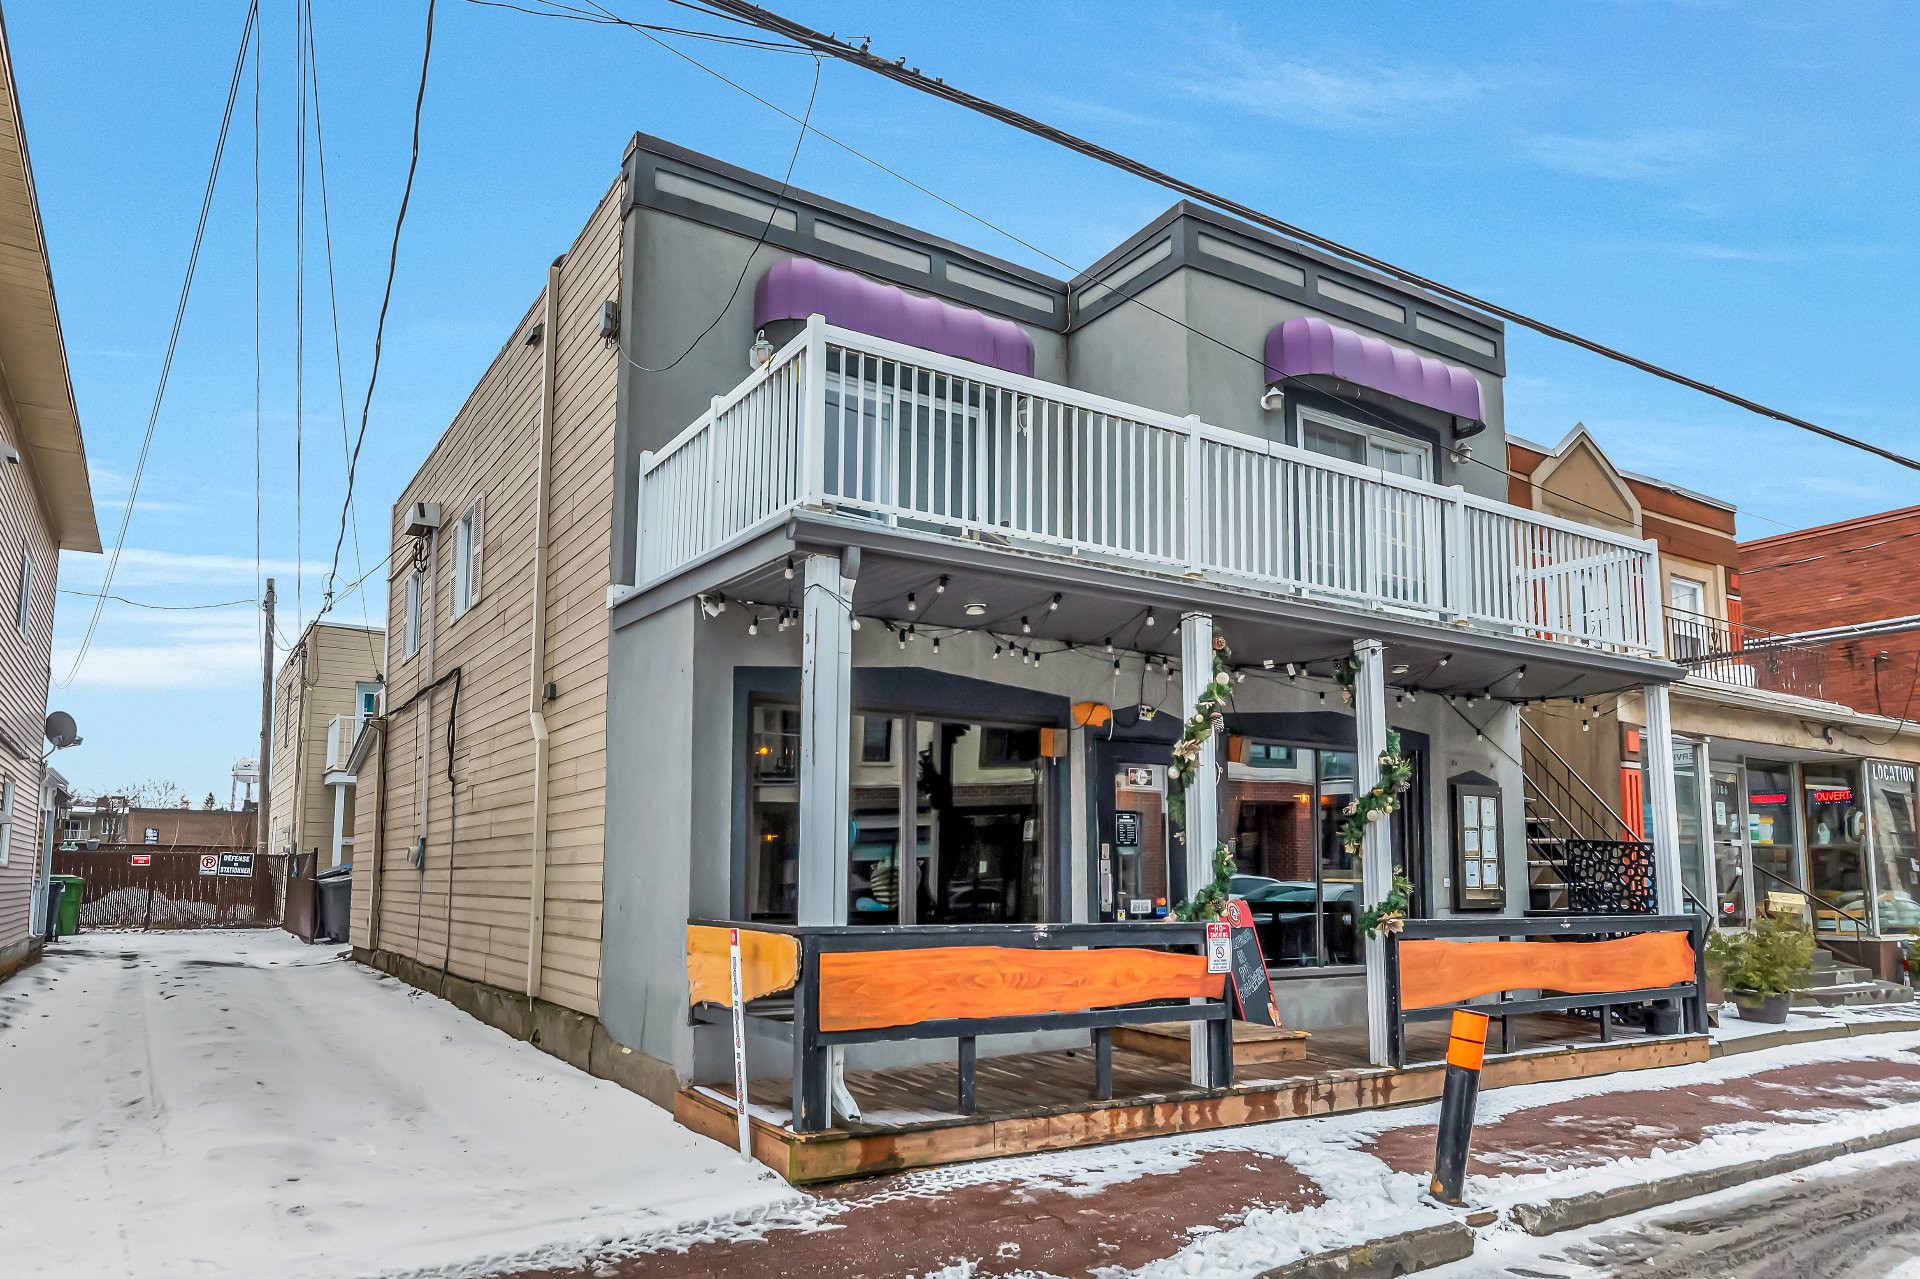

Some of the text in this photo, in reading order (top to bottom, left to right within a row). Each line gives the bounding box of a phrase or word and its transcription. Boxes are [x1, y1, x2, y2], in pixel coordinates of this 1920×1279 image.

[1872, 763, 1915, 783] LOCATION
[1816, 790, 1851, 801] OUVERT
[220, 866, 251, 874] STATIONNER
